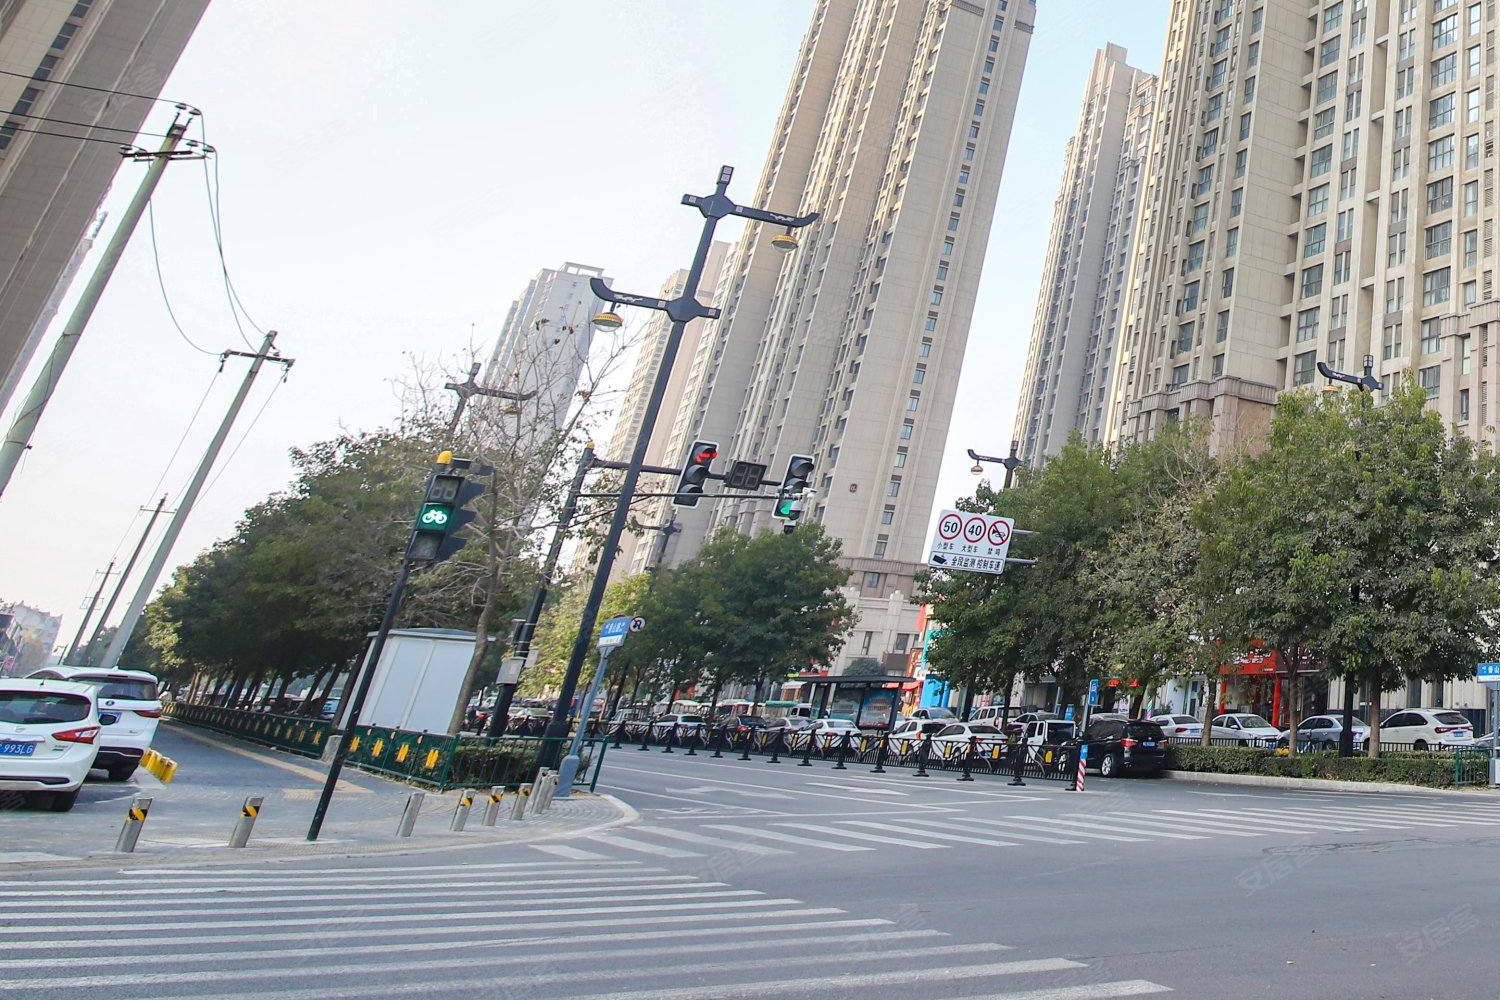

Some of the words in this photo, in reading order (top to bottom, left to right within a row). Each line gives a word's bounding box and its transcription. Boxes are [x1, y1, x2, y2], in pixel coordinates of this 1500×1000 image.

[943, 522, 958, 533] 50
[968, 525, 982, 536] 40
[937, 542, 954, 550] 小型车
[961, 545, 978, 553] 大型车
